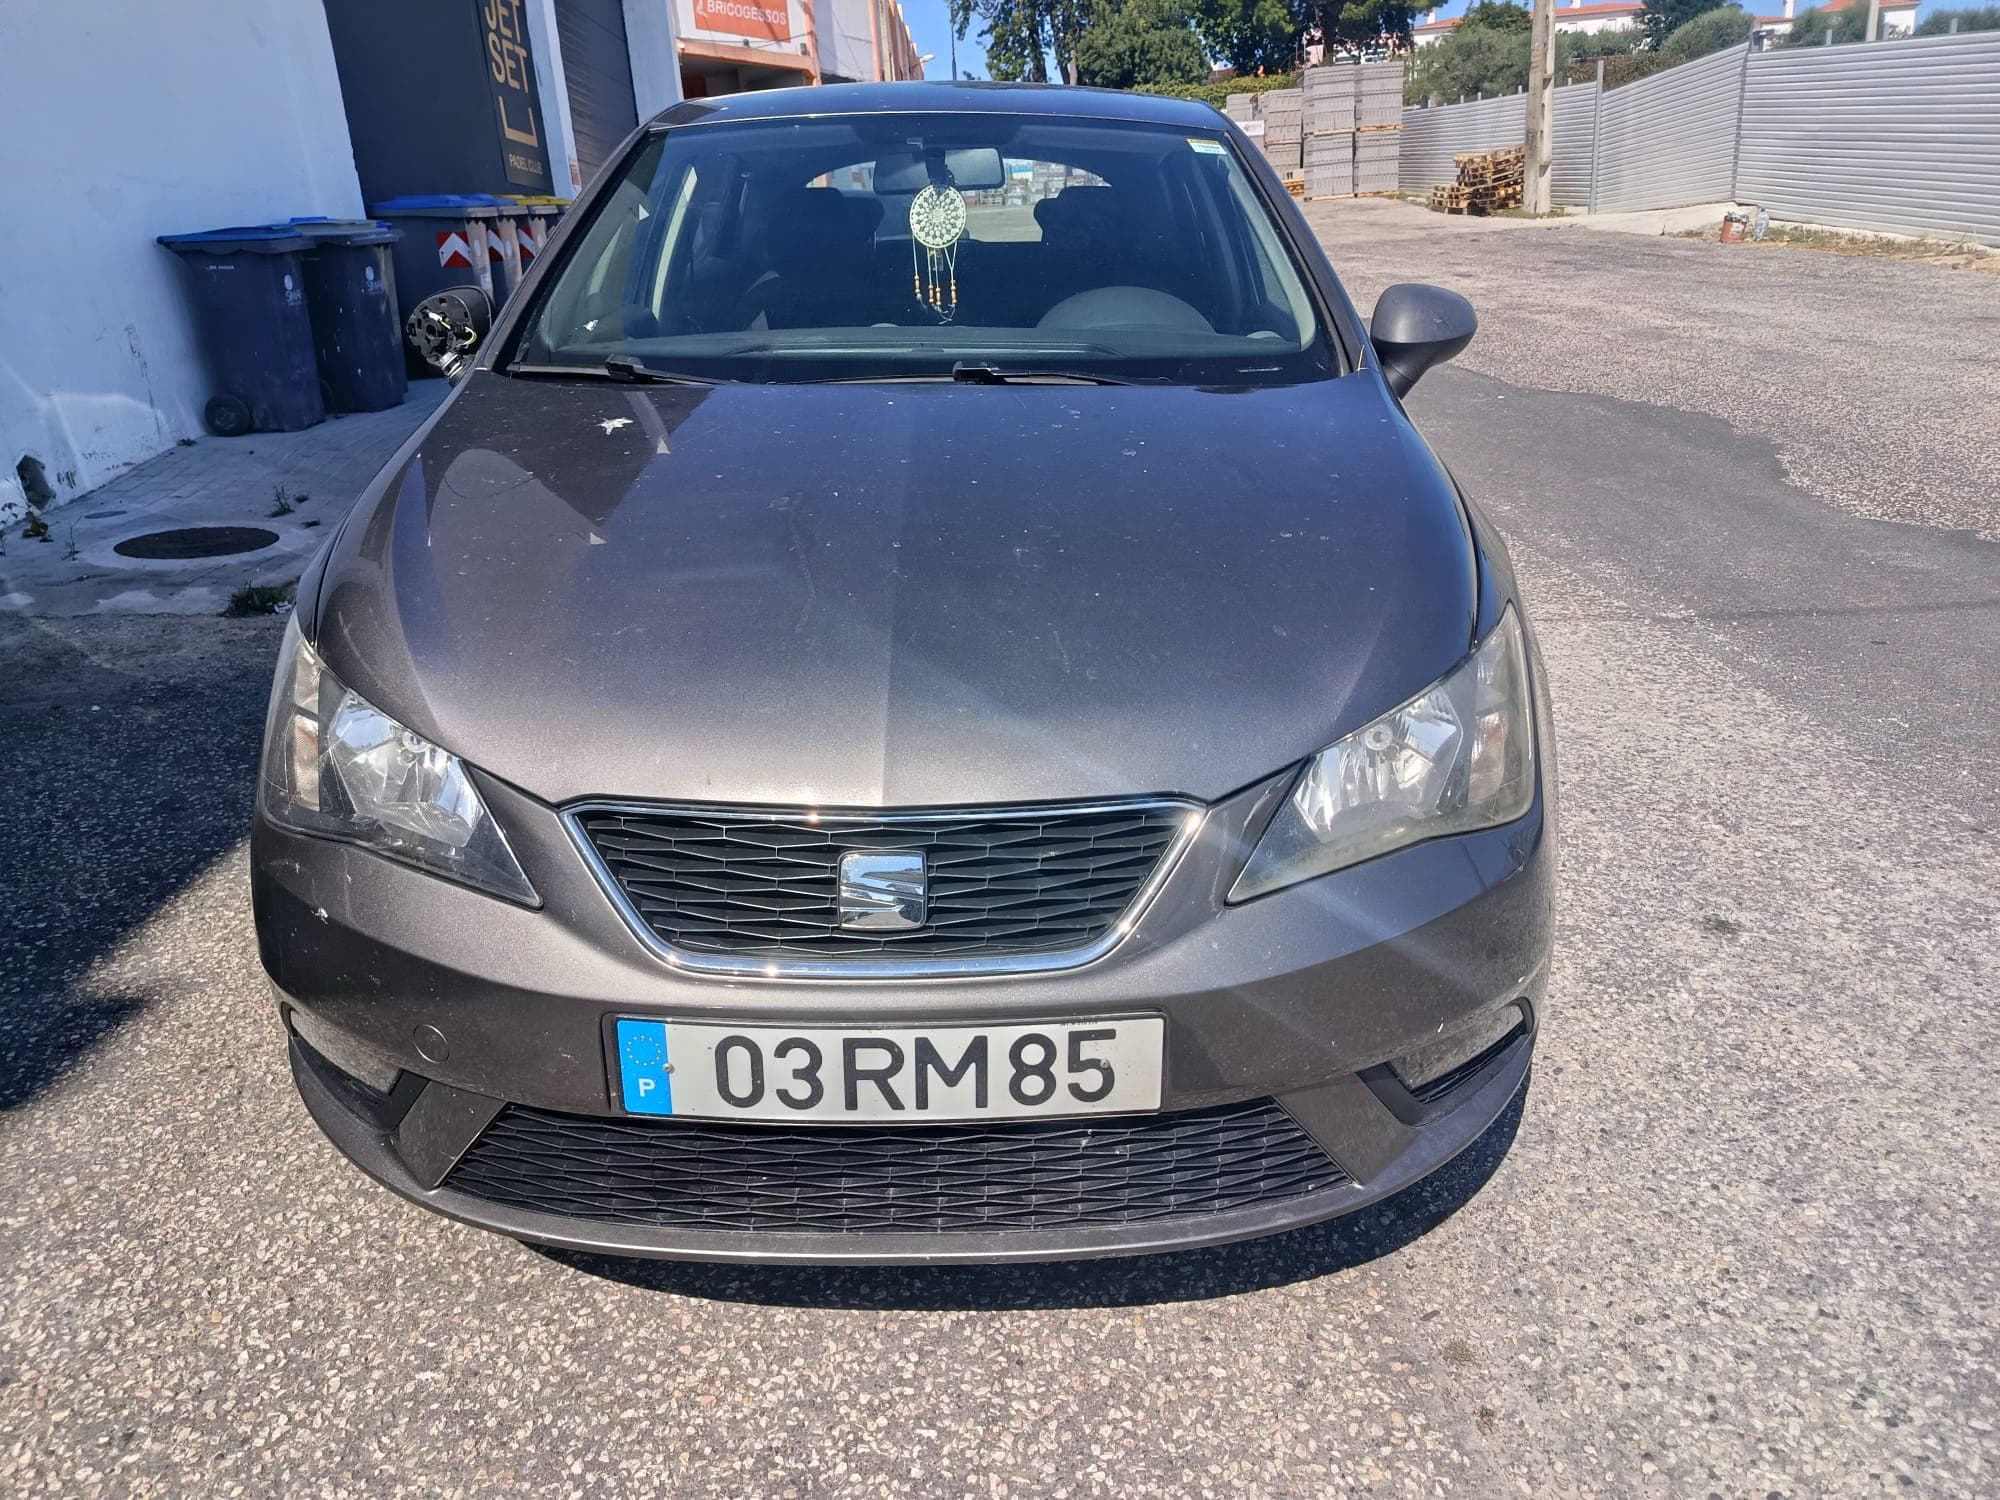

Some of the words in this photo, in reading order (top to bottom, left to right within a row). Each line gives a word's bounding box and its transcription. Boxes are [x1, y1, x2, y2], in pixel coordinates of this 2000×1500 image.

[707, 0, 786, 24] BRICOGESSOS
[488, 32, 528, 93] SET
[638, 1077, 655, 1098] P
